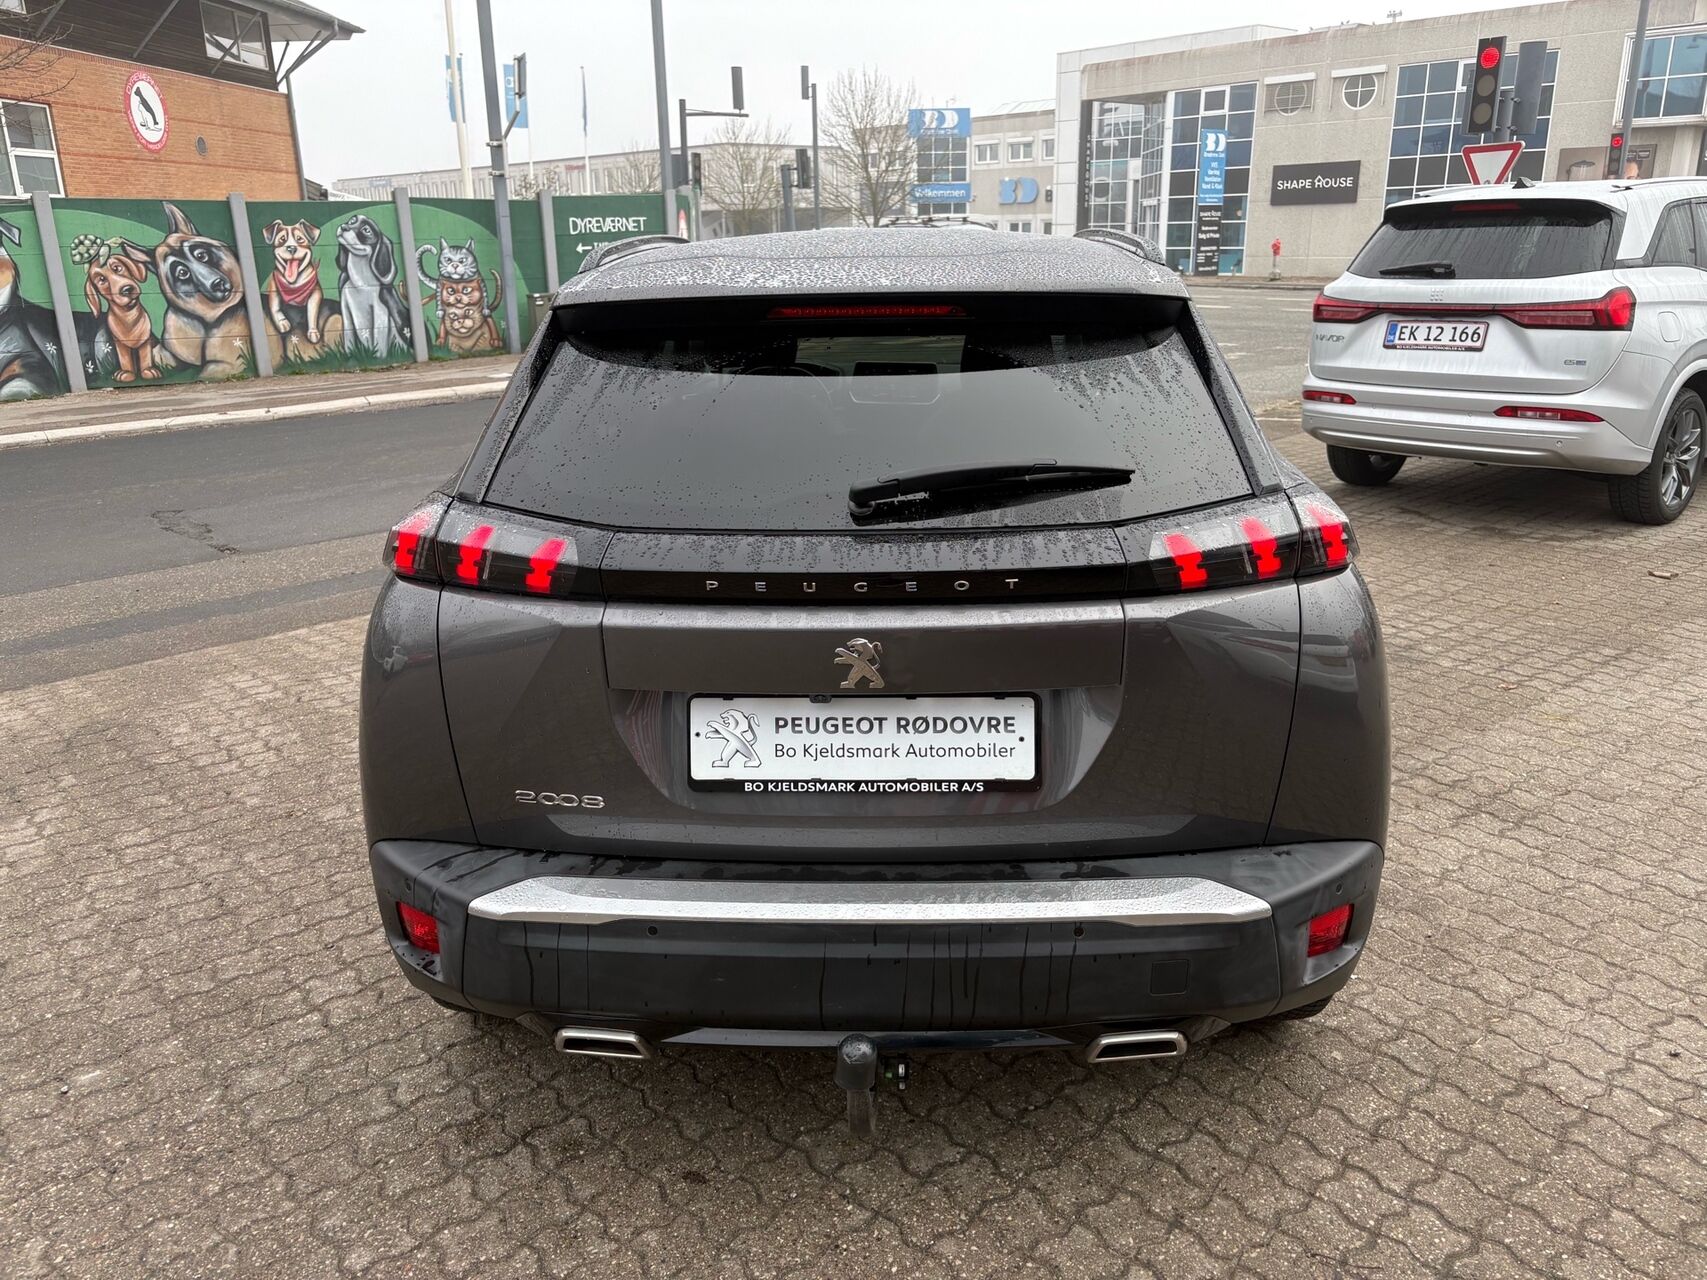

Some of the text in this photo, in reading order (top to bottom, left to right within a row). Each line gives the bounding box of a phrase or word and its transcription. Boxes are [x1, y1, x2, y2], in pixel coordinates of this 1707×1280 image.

[1277, 175, 1354, 190] SHAPE HOUSE
[914, 187, 967, 198] Velkommen
[569, 217, 647, 235] DYREVÆRNET
[1398, 325, 1482, 343] EK 12 166
[705, 578, 1020, 593] PEUGEOT
[774, 715, 1016, 734] PEUGEOT RØDOVRE
[774, 742, 1016, 763] Bo Kjeldsmark Automobiler
[744, 782, 985, 793] BO KJELDSMARK AUTOMOBILER A/S
[515, 790, 605, 808] 2008
